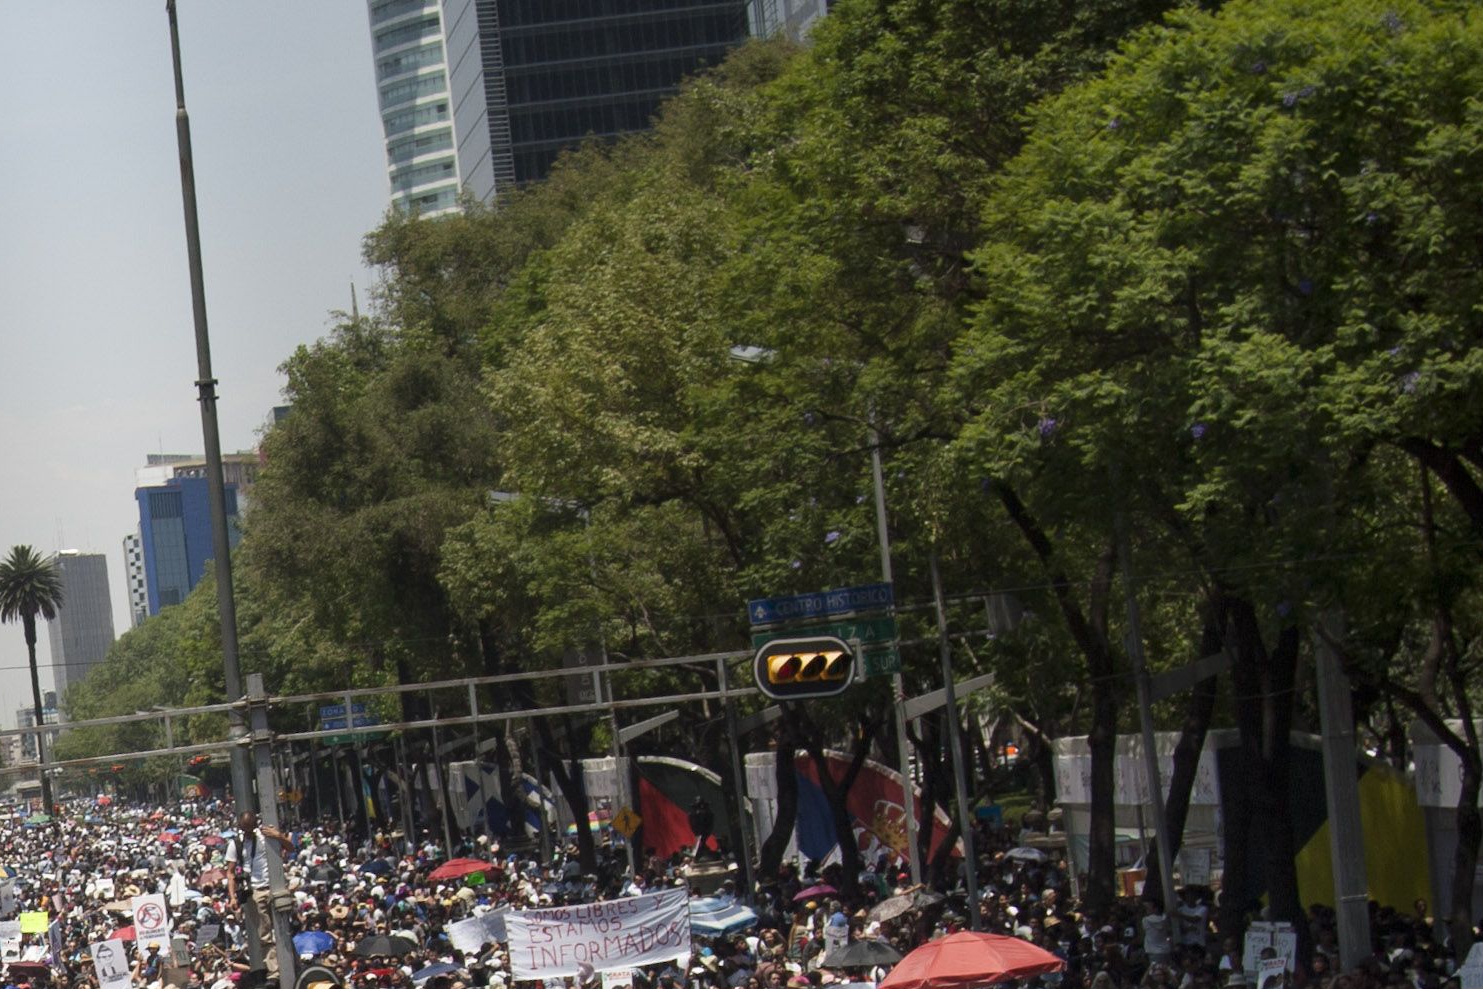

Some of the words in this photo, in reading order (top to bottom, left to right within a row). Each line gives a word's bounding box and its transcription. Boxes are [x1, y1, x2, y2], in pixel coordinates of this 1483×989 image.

[775, 597, 822, 616] CENTRO
[826, 588, 888, 607] HISTORICO
[872, 655, 896, 671] SUR
[523, 908, 571, 924] SOMOS
[576, 900, 638, 919] LIBRES
[653, 894, 665, 910] Y
[528, 916, 622, 944] ESTAMOS
[526, 921, 682, 970] INFORMADOS
